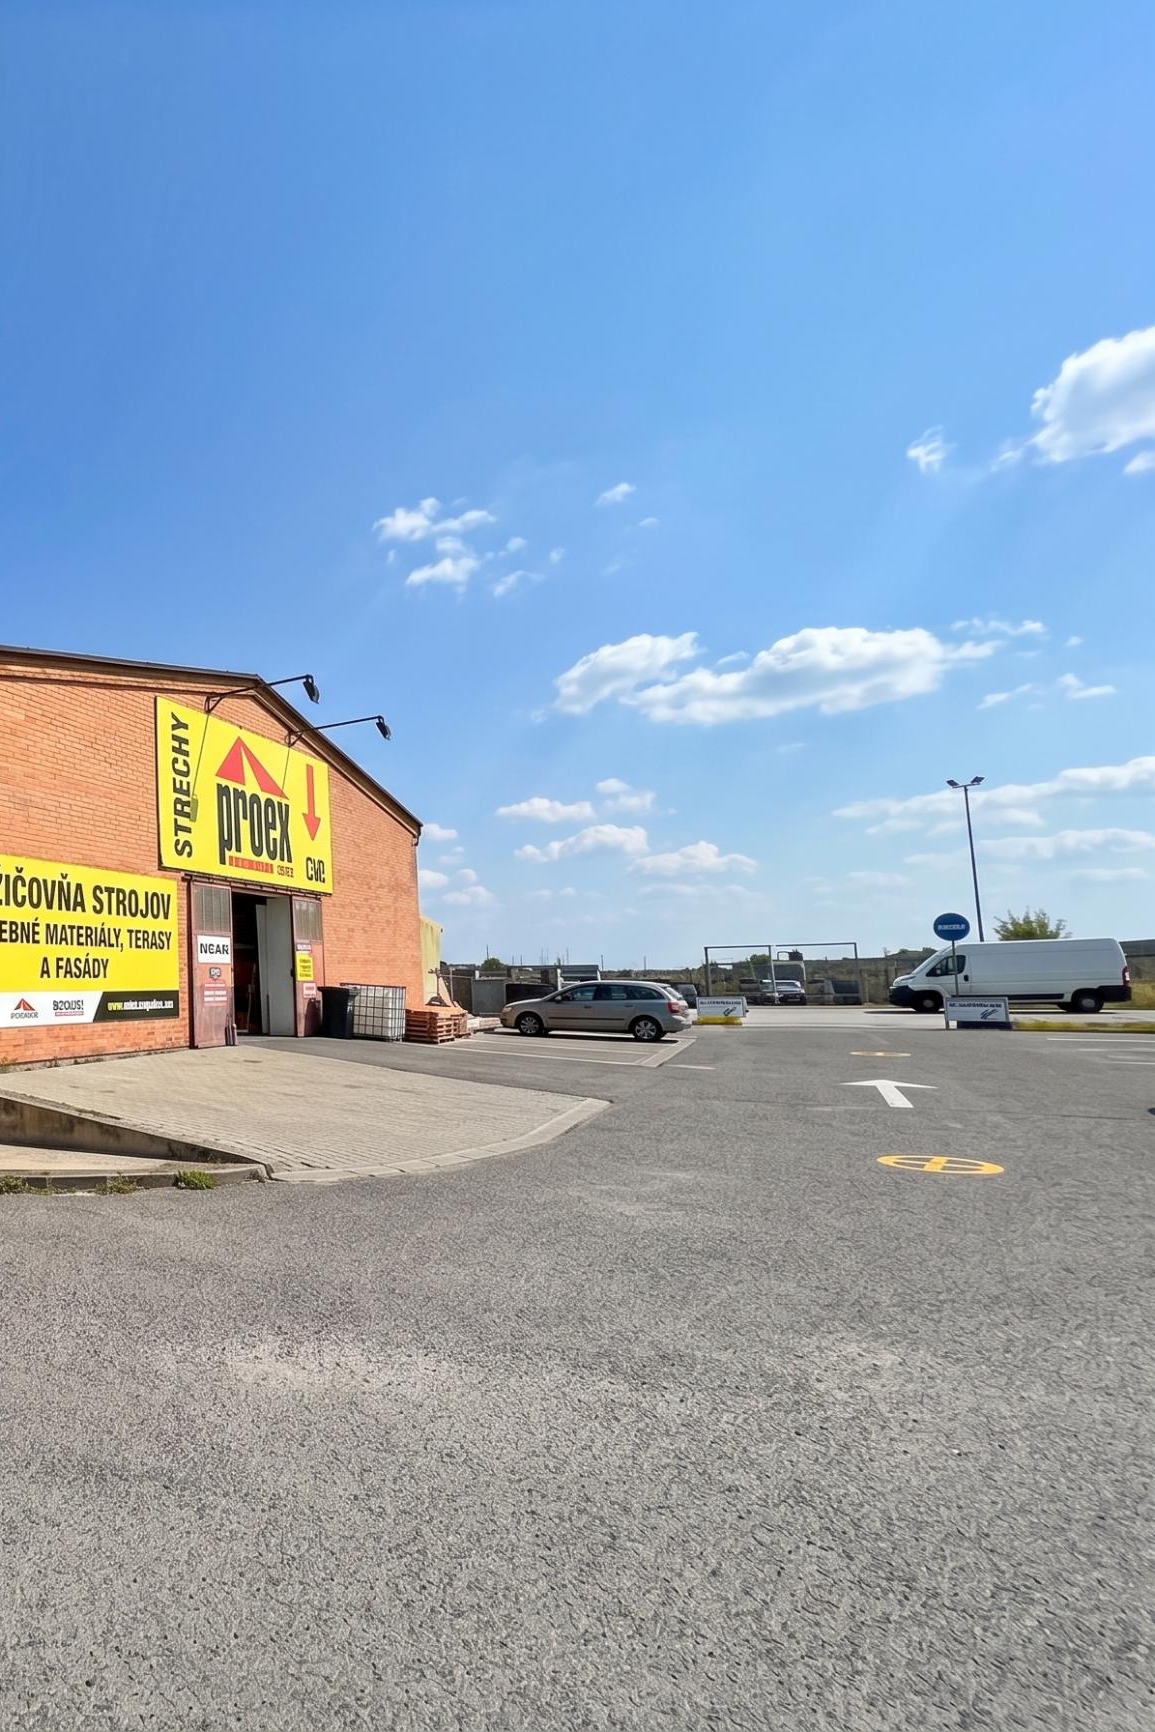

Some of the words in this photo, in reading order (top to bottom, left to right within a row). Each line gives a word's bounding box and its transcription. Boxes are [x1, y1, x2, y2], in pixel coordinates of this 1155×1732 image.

[170, 711, 193, 859] STRECHY
[216, 782, 293, 866] proex
[92, 884, 171, 920] STROJOV
[45, 922, 124, 952] MATERIÁLY,
[127, 929, 172, 950] TERASY
[40, 957, 51, 979] A
[55, 953, 109, 979] FASÁDY
